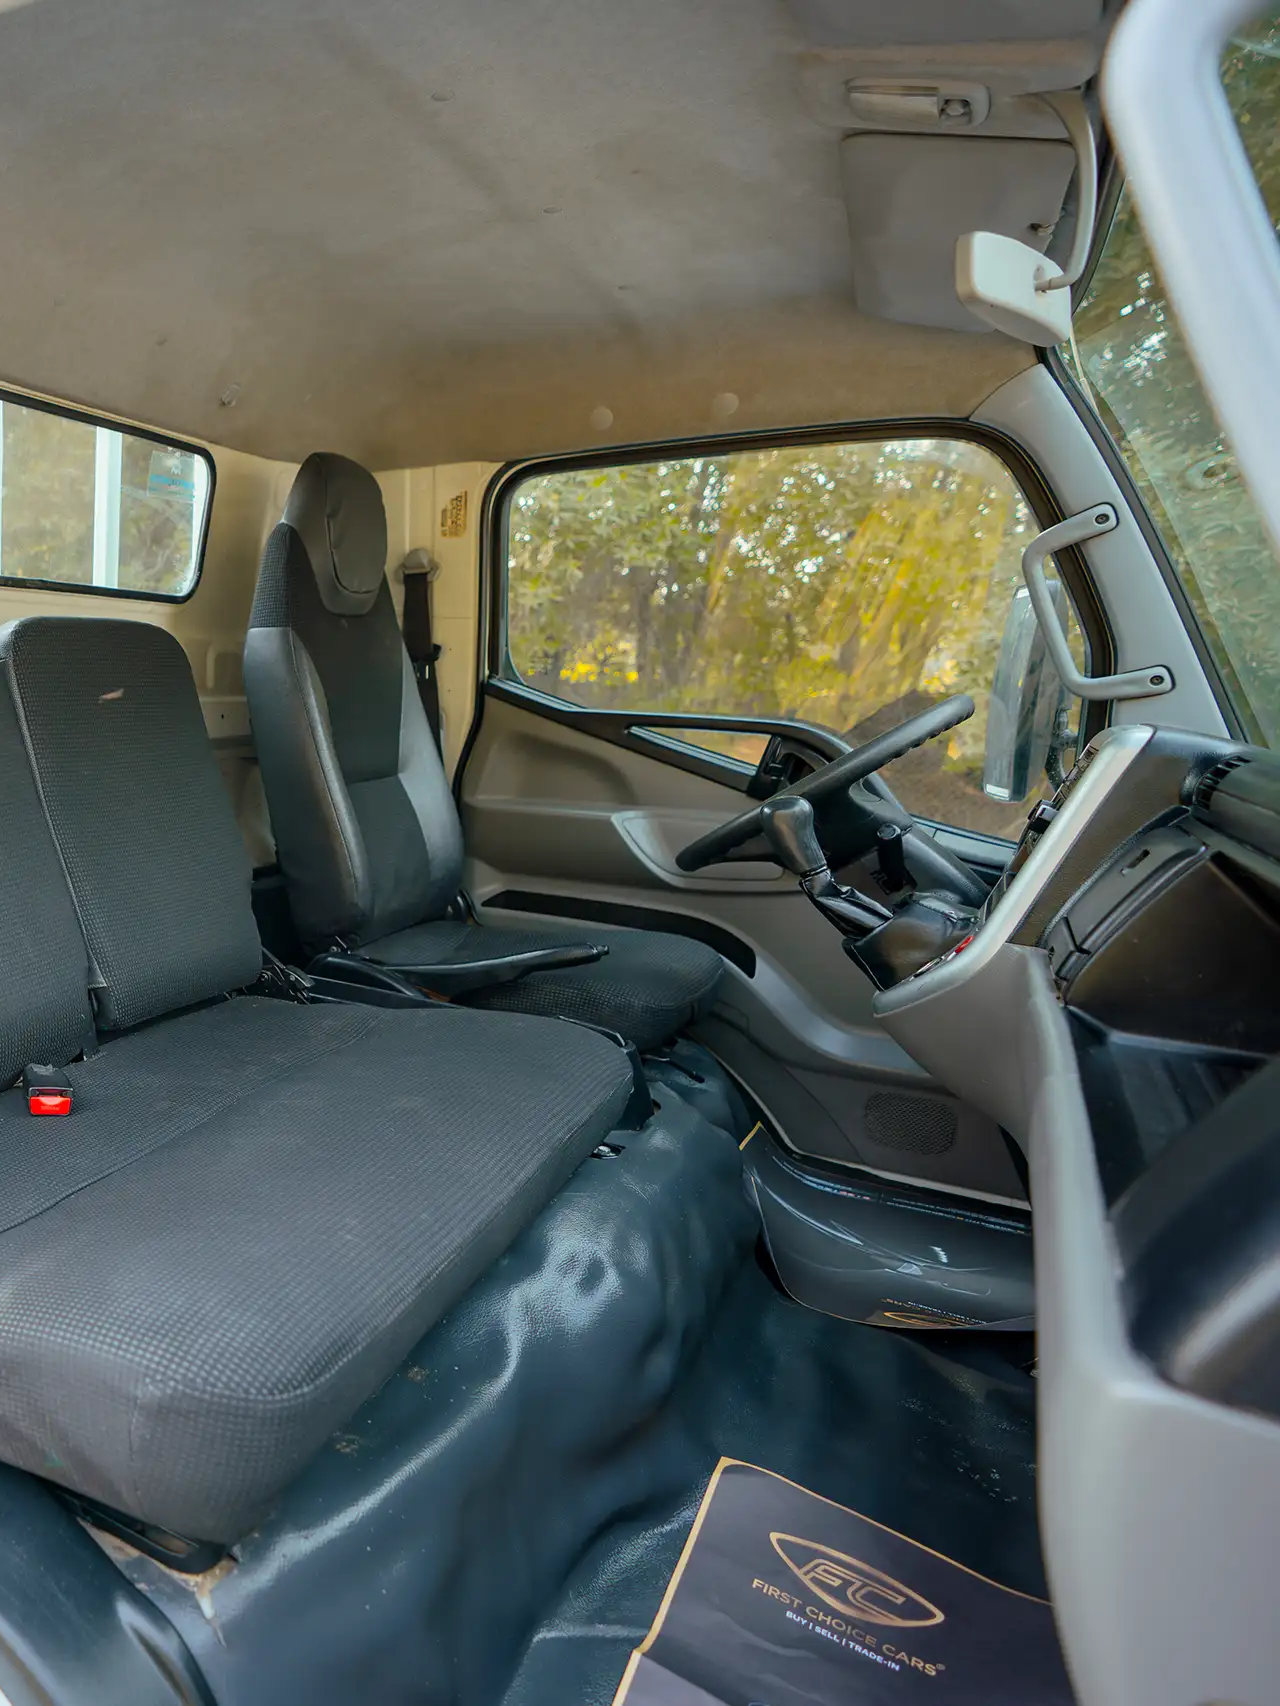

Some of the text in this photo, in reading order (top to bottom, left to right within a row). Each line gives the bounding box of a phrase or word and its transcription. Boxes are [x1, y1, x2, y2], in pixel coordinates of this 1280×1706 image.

[752, 1578, 802, 1608] FIRST
[806, 1606, 877, 1647] CHOICE
[785, 1610, 807, 1625] BUY
[814, 1626, 840, 1643] SELL
[848, 1641, 900, 1671] TRADE-IN
